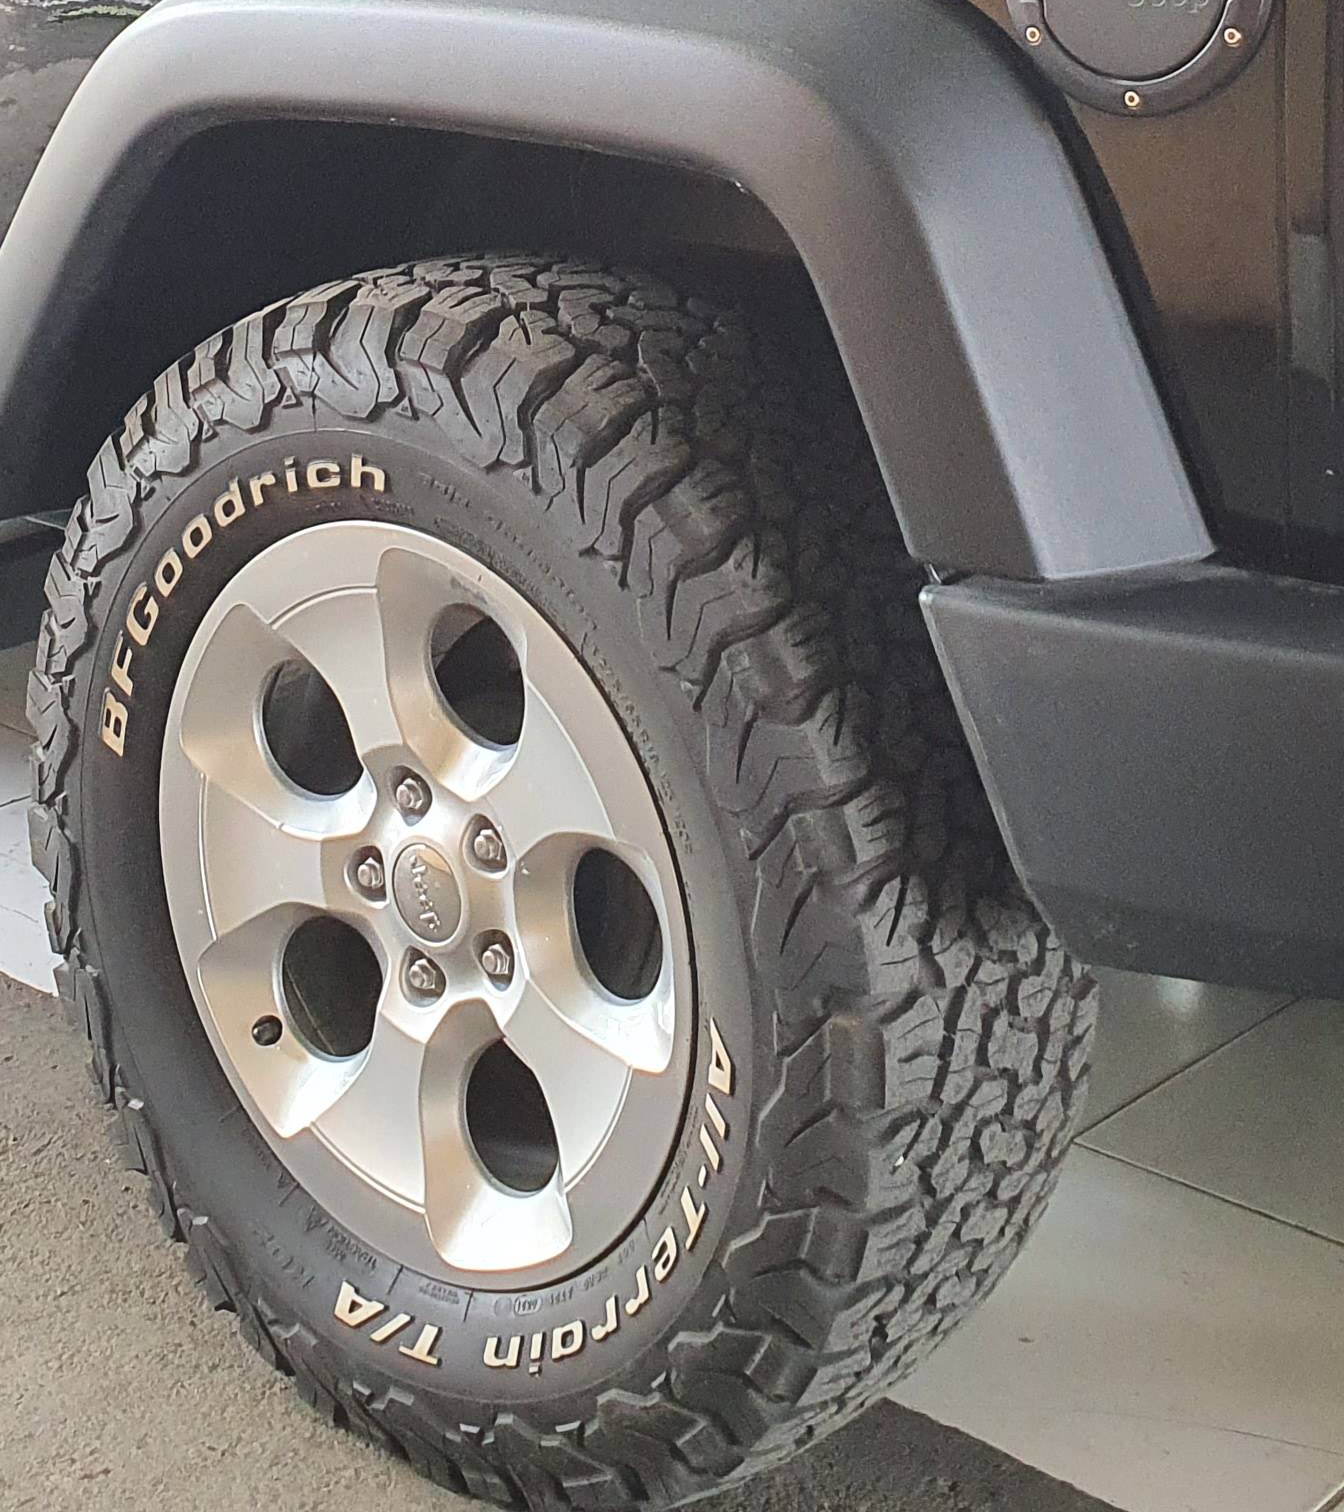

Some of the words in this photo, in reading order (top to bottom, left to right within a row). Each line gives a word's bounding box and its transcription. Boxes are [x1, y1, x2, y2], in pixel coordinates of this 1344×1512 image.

[101, 452, 387, 758] BFGoodrich
[332, 1278, 444, 1368] T/A
[483, 1015, 734, 1377] All-Terrain
